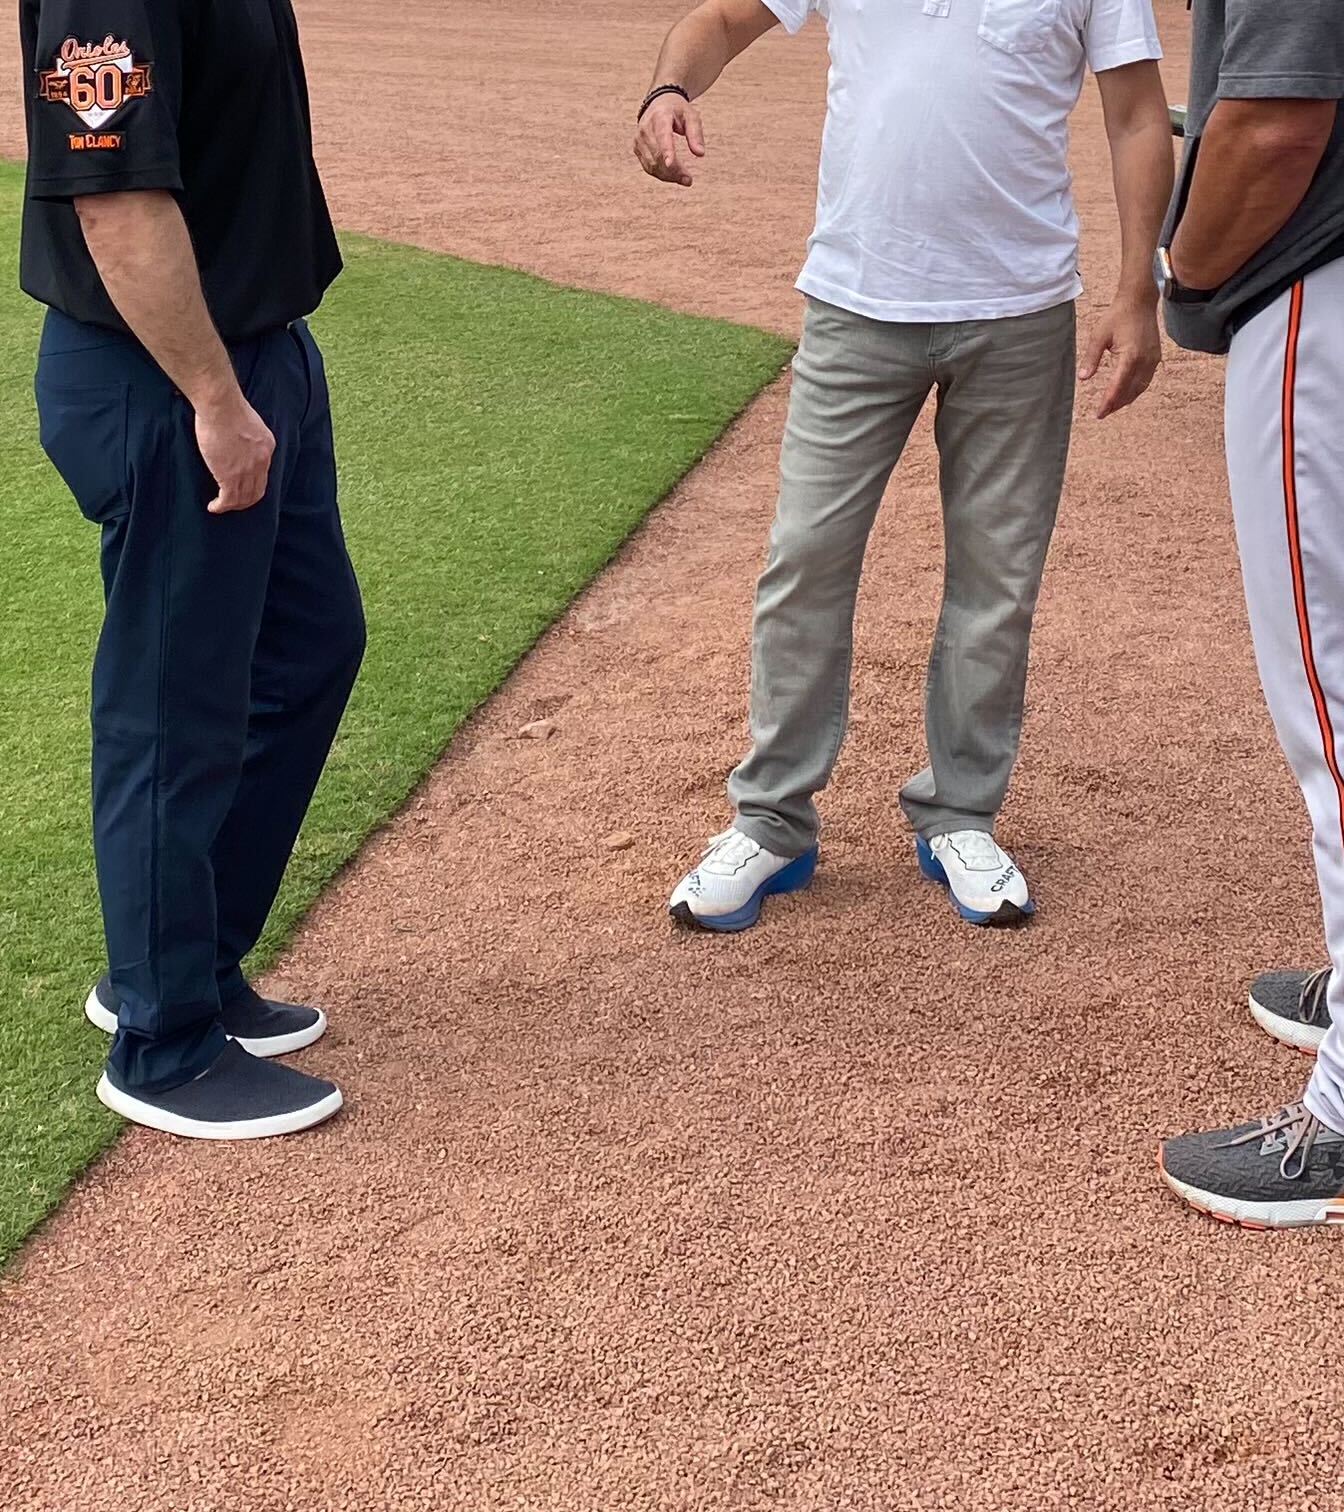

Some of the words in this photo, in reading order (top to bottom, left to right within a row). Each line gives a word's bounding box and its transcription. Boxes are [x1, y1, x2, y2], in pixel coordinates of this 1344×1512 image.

[61, 35, 130, 62] Orioles
[69, 64, 123, 111] 60
[85, 134, 122, 148] CLANCY
[990, 865, 1019, 893] CRAFT
